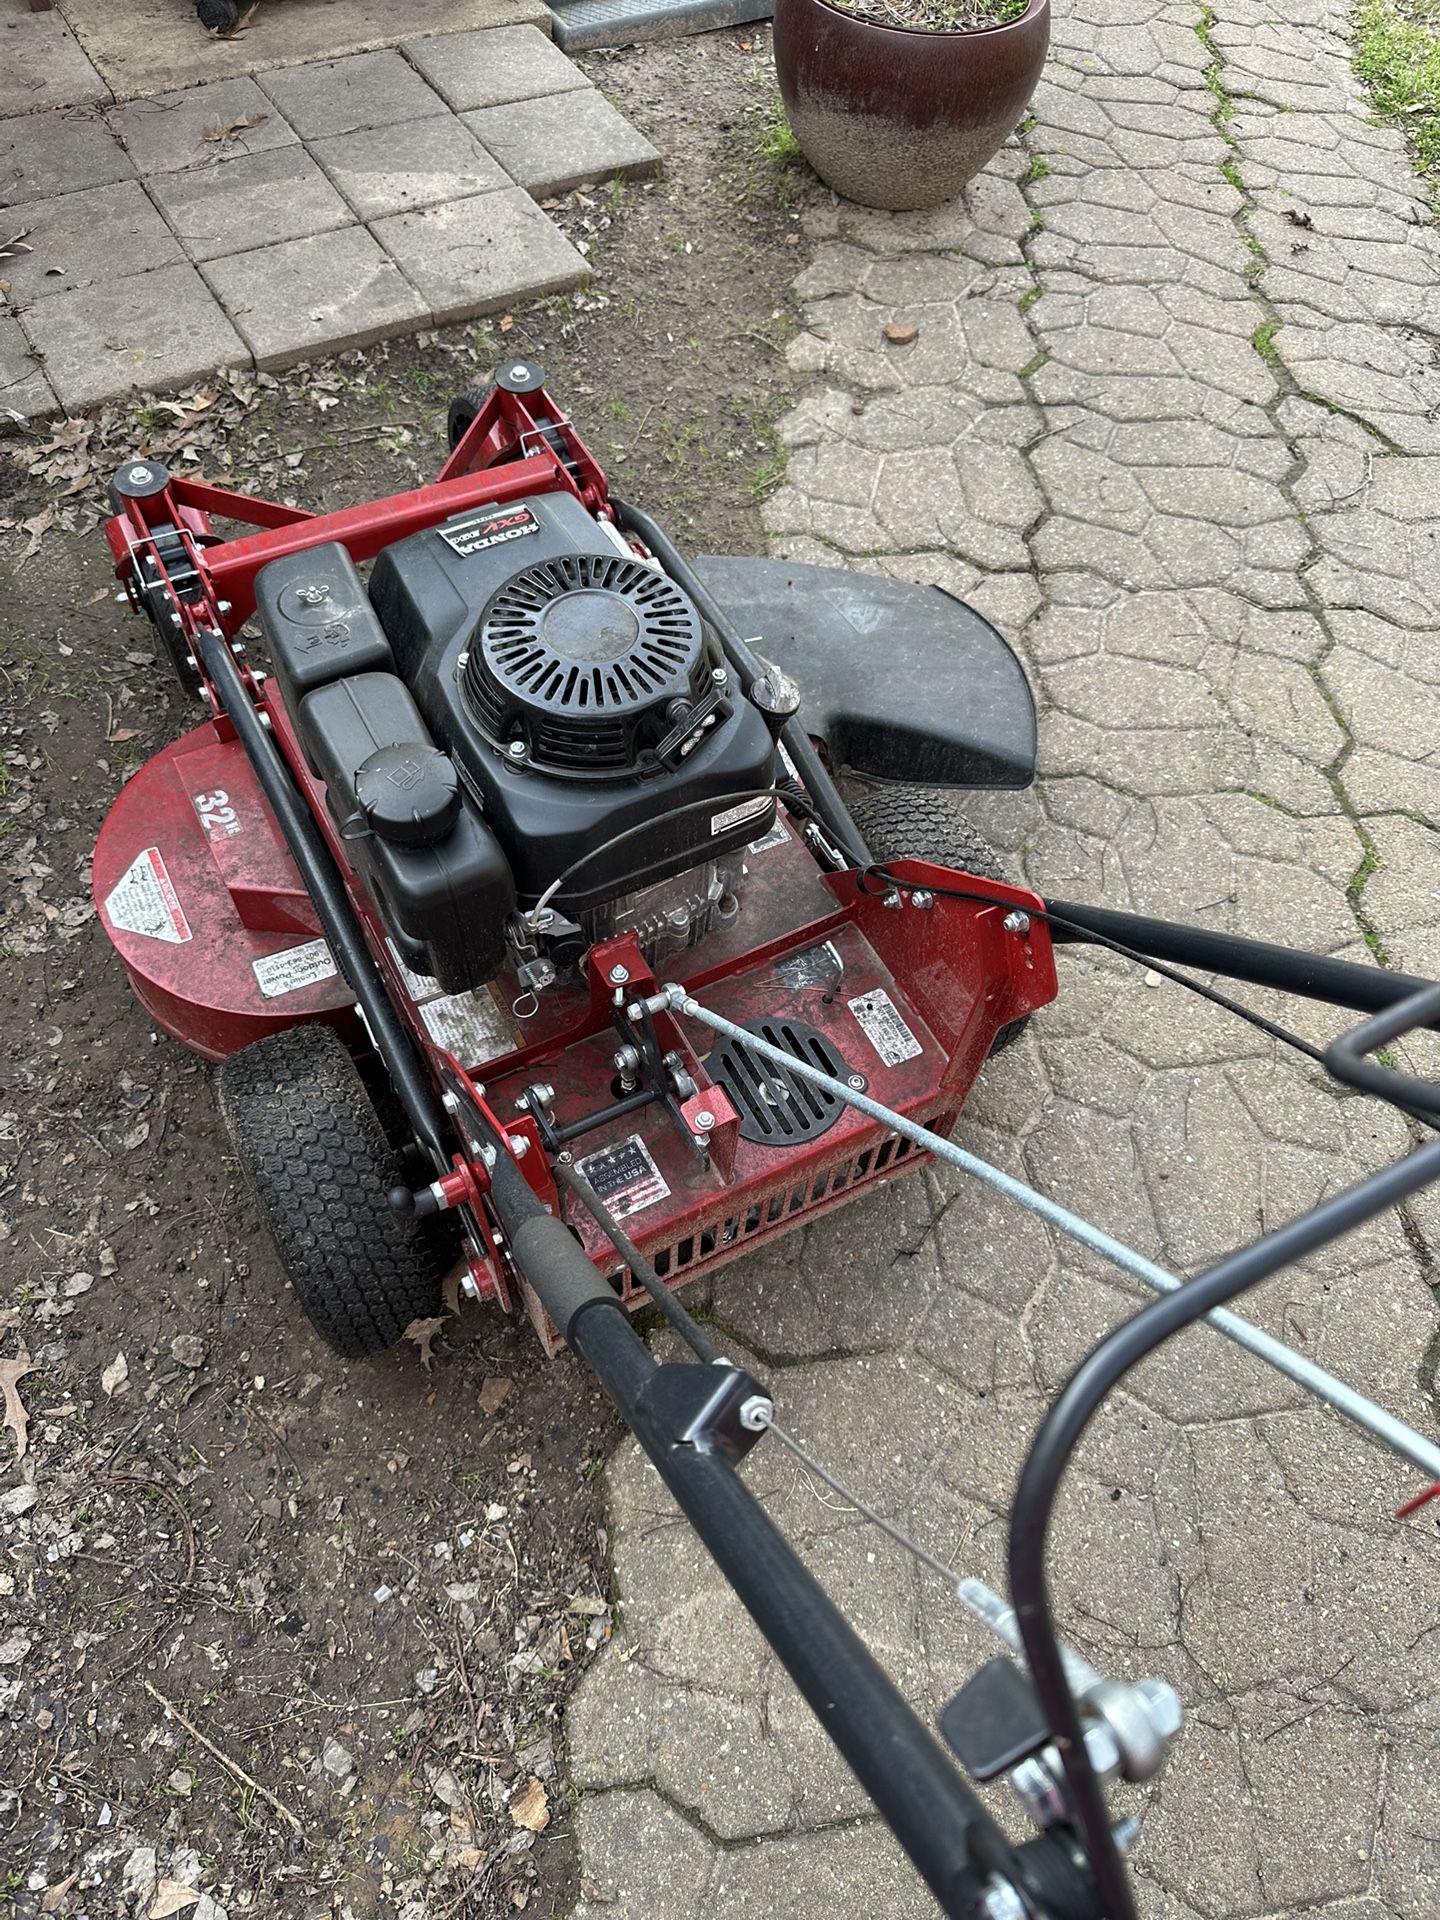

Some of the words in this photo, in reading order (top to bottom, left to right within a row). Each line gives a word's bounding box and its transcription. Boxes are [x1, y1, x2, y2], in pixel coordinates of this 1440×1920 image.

[482, 513, 530, 535] GXV
[459, 522, 540, 553] HONDA
[262, 971, 292, 986] Power
[294, 958, 331, 974] Outdoor
[594, 1157, 643, 1185] ASSEMBLED
[598, 1183, 608, 1193] IN
[608, 1178, 624, 1188] THE
[623, 1165, 647, 1180] USA
